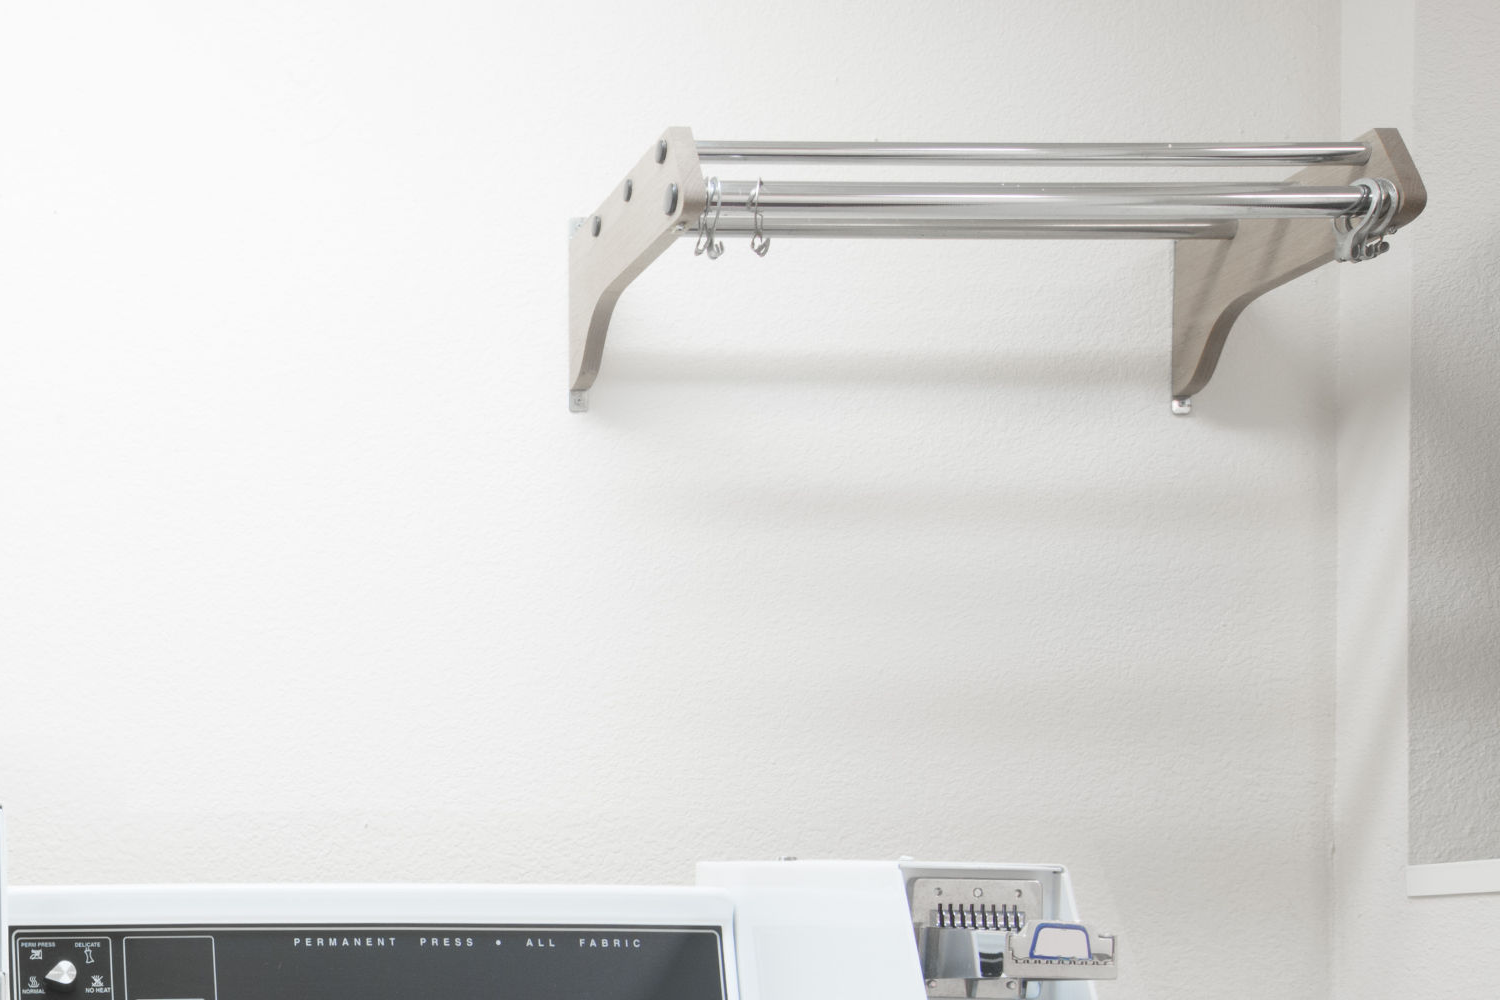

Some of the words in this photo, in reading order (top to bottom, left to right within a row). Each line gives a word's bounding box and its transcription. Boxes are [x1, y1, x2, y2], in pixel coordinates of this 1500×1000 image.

[294, 937, 396, 947] PERMANENT
[419, 937, 474, 947] PRESS
[526, 938, 557, 948] ALL
[579, 938, 642, 948] FABRIC
